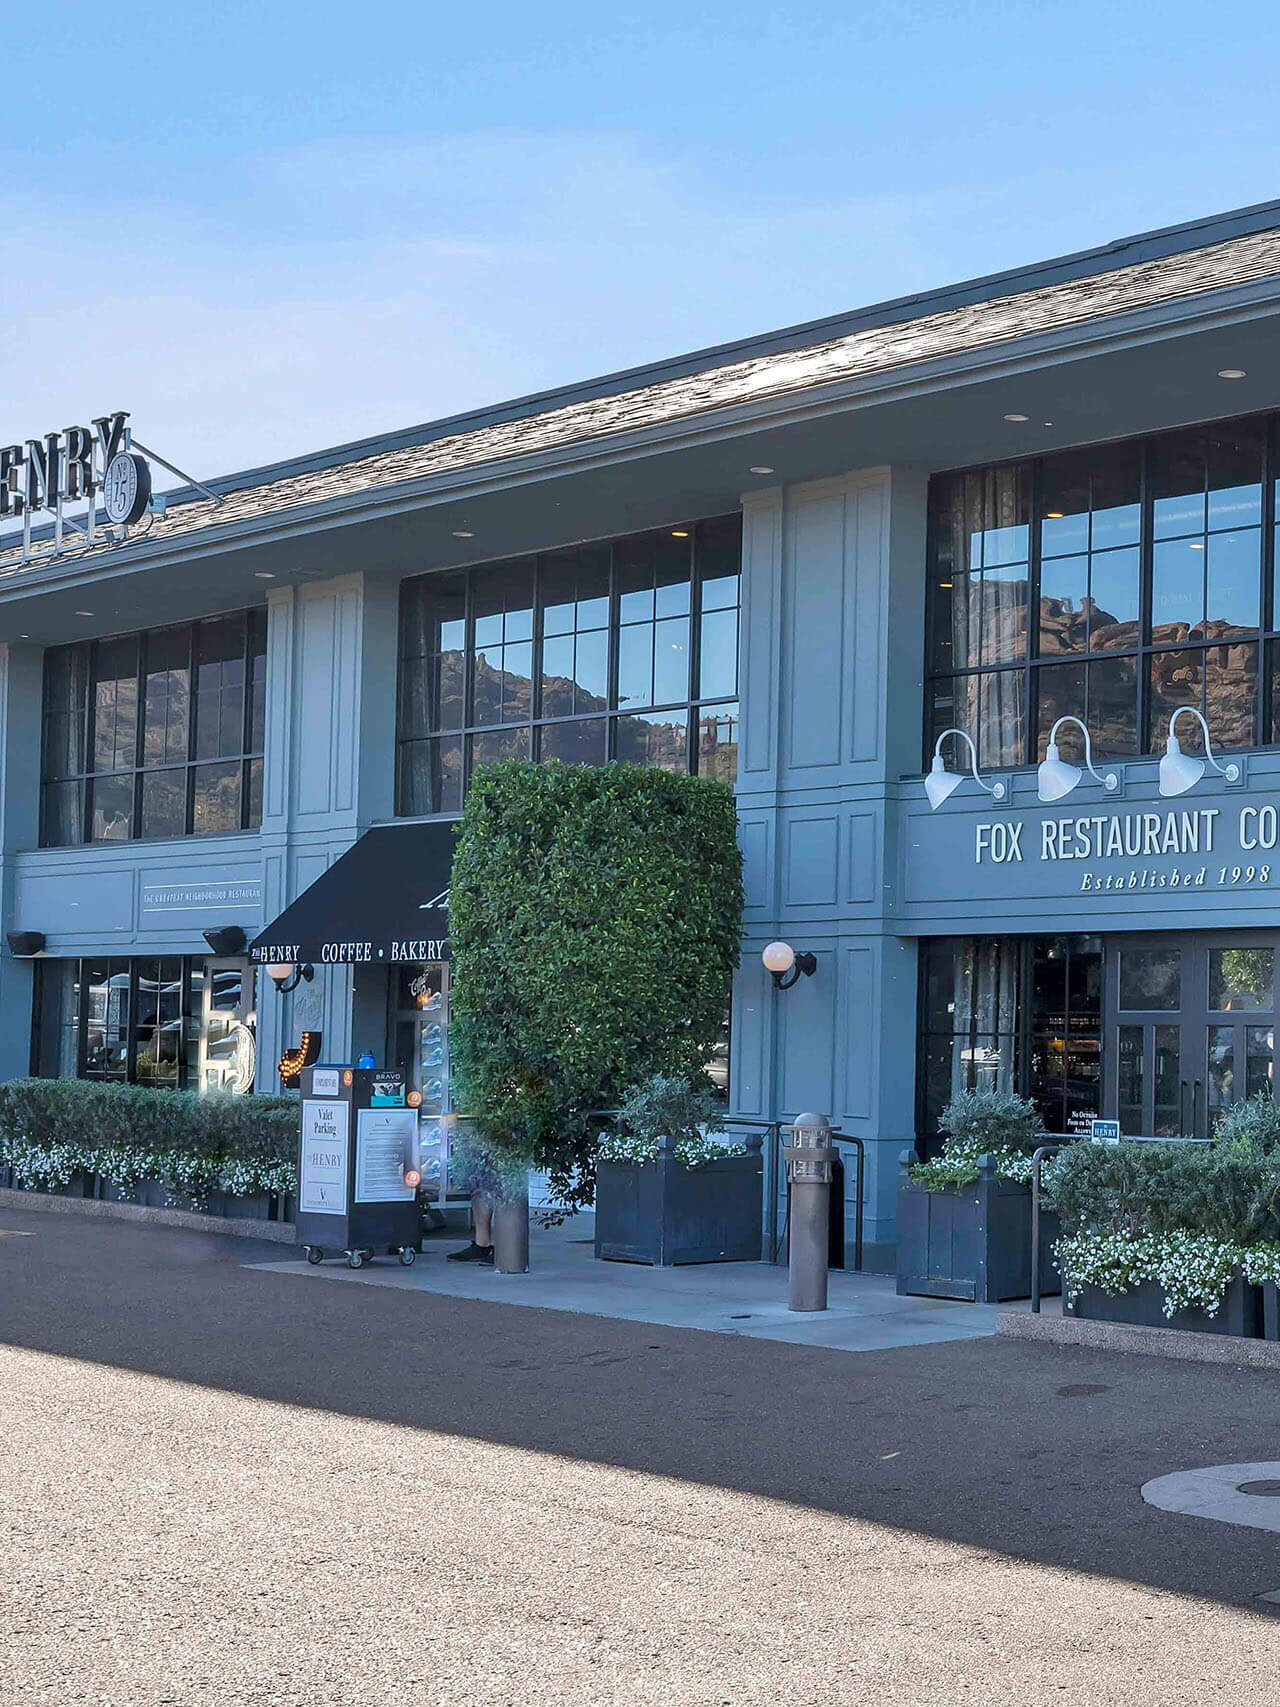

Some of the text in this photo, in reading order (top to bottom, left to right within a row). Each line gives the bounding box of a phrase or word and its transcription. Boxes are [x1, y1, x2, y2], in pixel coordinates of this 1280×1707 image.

[113, 479, 128, 512] 15
[975, 822, 1024, 864] FOX
[1040, 808, 1220, 861] RESTAURANT
[1081, 864, 1272, 891] Established 1998
[260, 945, 300, 962] HENRY
[321, 940, 446, 962] COFFEE BAKERY
[318, 1108, 333, 1121] Valet
[314, 1122, 337, 1137] Parking
[1094, 1127, 1116, 1137] HENRY
[312, 1152, 343, 1167] HENRY
